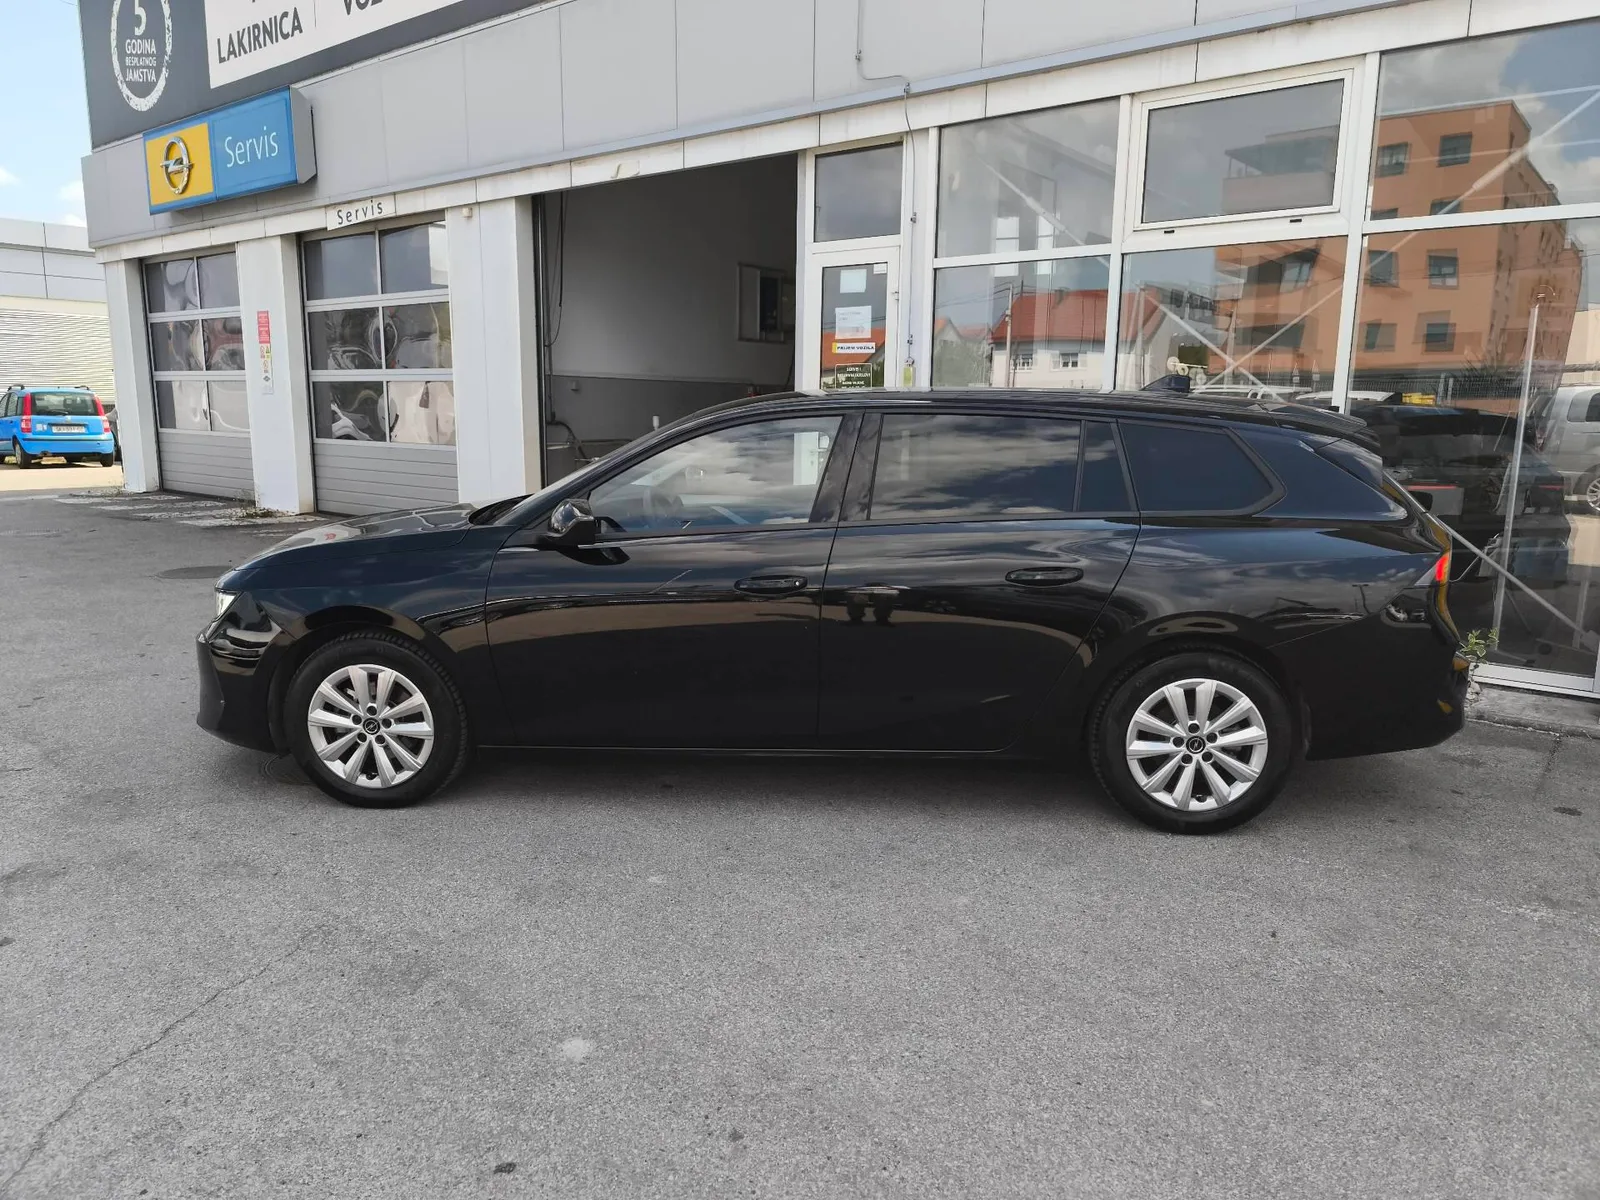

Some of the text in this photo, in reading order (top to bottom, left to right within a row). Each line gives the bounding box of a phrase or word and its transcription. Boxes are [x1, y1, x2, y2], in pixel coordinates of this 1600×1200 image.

[134, 0, 147, 36] 5
[125, 38, 157, 55] GODINA
[217, 7, 303, 64] LAKIRNICA
[125, 56, 157, 67] BESPLATNOG
[125, 68, 157, 83] JAMSTVA
[224, 125, 279, 168] Servis
[337, 199, 383, 225] Servis
